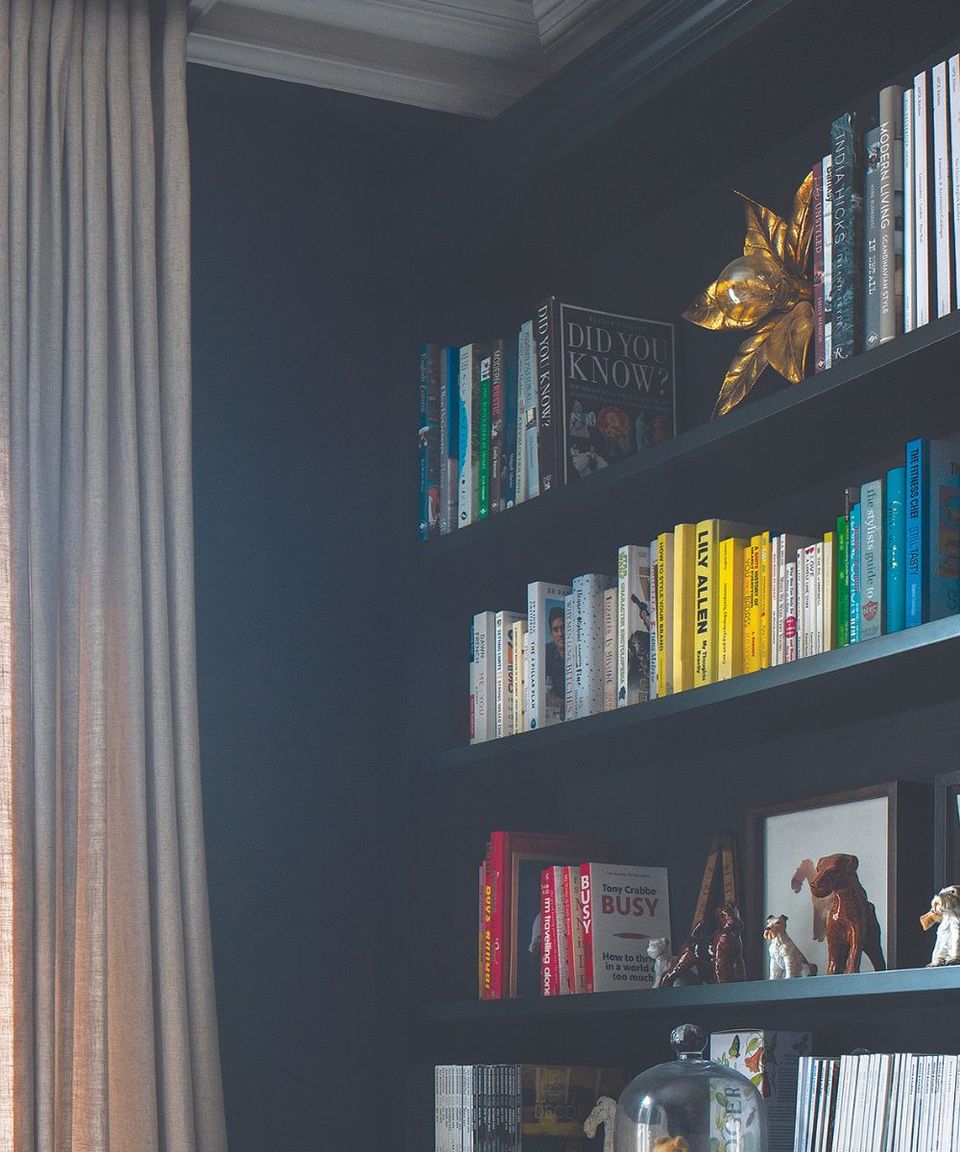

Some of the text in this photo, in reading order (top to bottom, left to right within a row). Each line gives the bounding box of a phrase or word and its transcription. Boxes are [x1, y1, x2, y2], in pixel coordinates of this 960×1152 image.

[835, 133, 845, 184] INDIA
[880, 121, 890, 181] MODERN
[835, 188, 845, 245] HICKS
[880, 183, 890, 229] LIVING
[882, 290, 890, 313] STYLE
[567, 321, 613, 354] DID
[616, 331, 669, 364] YOU
[538, 305, 552, 428] DID YOU KNOW?
[567, 350, 670, 396] KNOW?
[909, 448, 918, 520] THE FITNESS CHEF
[864, 489, 877, 599] the stylists guide to
[909, 526, 918, 577] STILL TASTY
[659, 563, 664, 574] TO
[697, 530, 708, 635] LILY ALLEN
[702, 640, 707, 650] My
[581, 875, 591, 934] BUSY
[601, 895, 659, 917] BUSY
[602, 884, 657, 896] Tony Crabbe
[543, 915, 553, 964] travelling
[602, 952, 623, 962] How
[625, 953, 634, 962] to
[605, 961, 614, 971] in
[623, 962, 650, 972] world
[613, 972, 654, 982] too much
